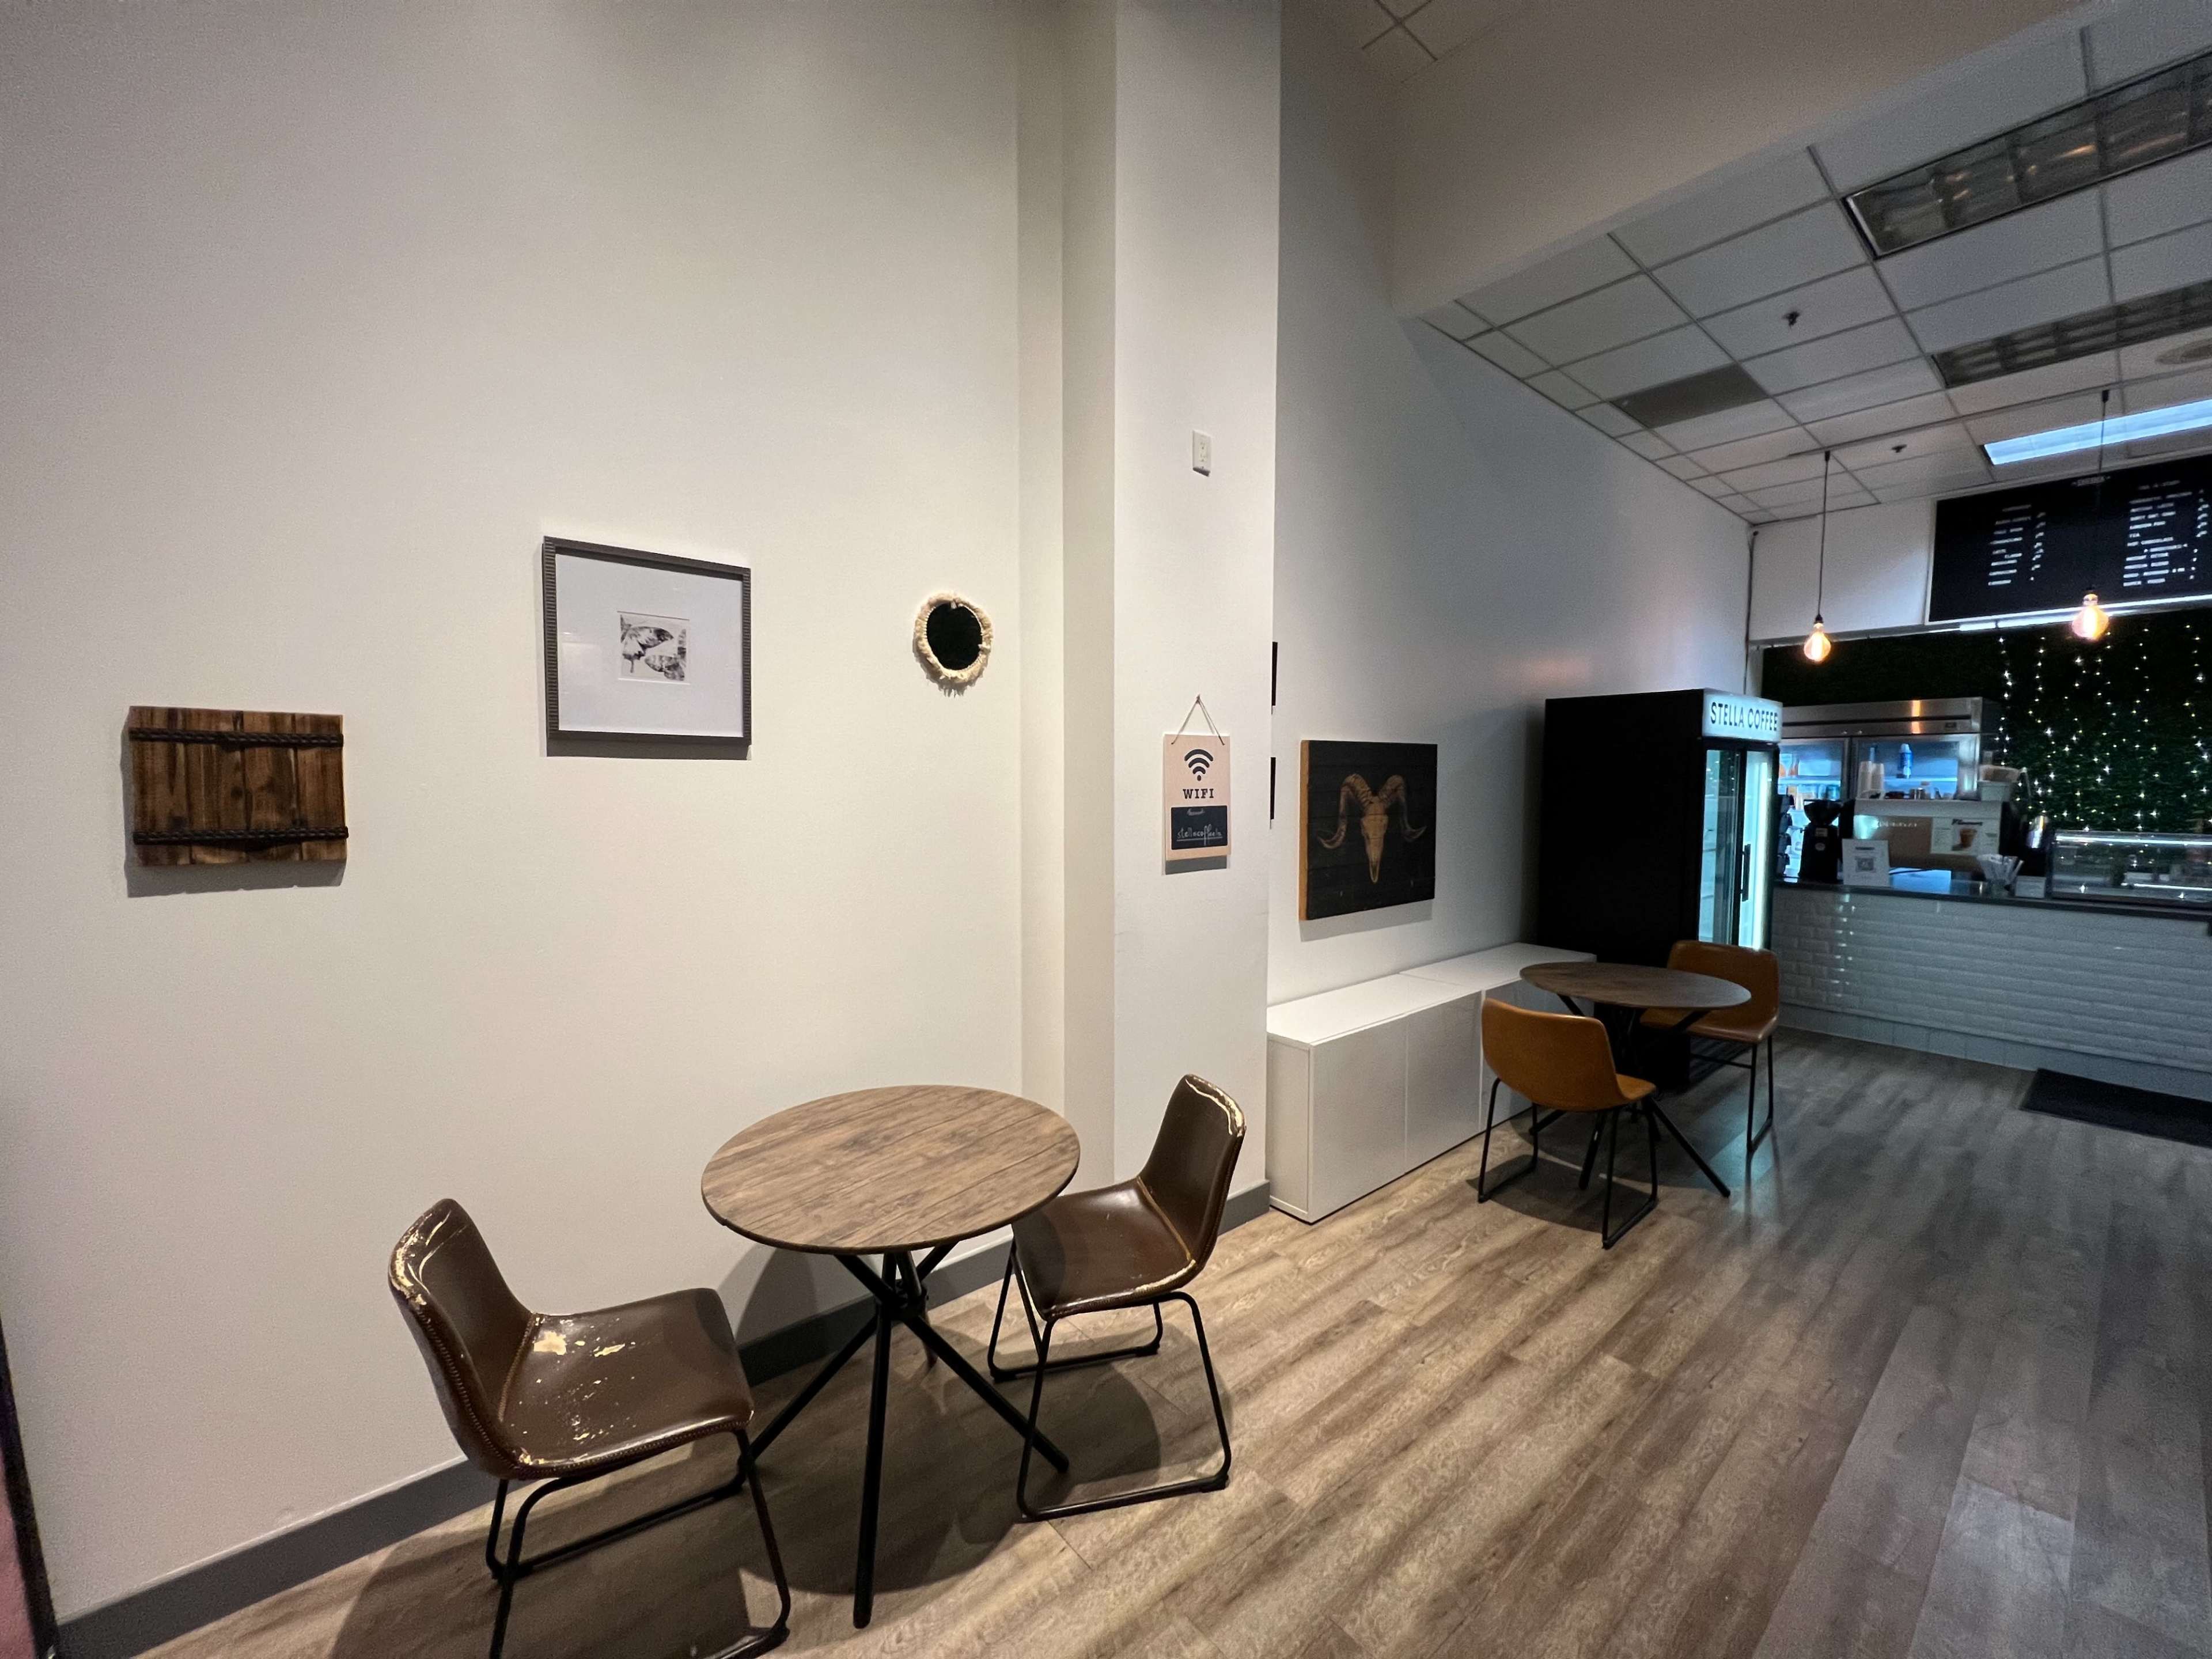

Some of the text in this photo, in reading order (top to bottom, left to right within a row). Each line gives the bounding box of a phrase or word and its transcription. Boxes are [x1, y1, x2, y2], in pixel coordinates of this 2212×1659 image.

[1710, 702, 1778, 732] STELLA COFFEE
[1183, 789, 1214, 799] WIFI
